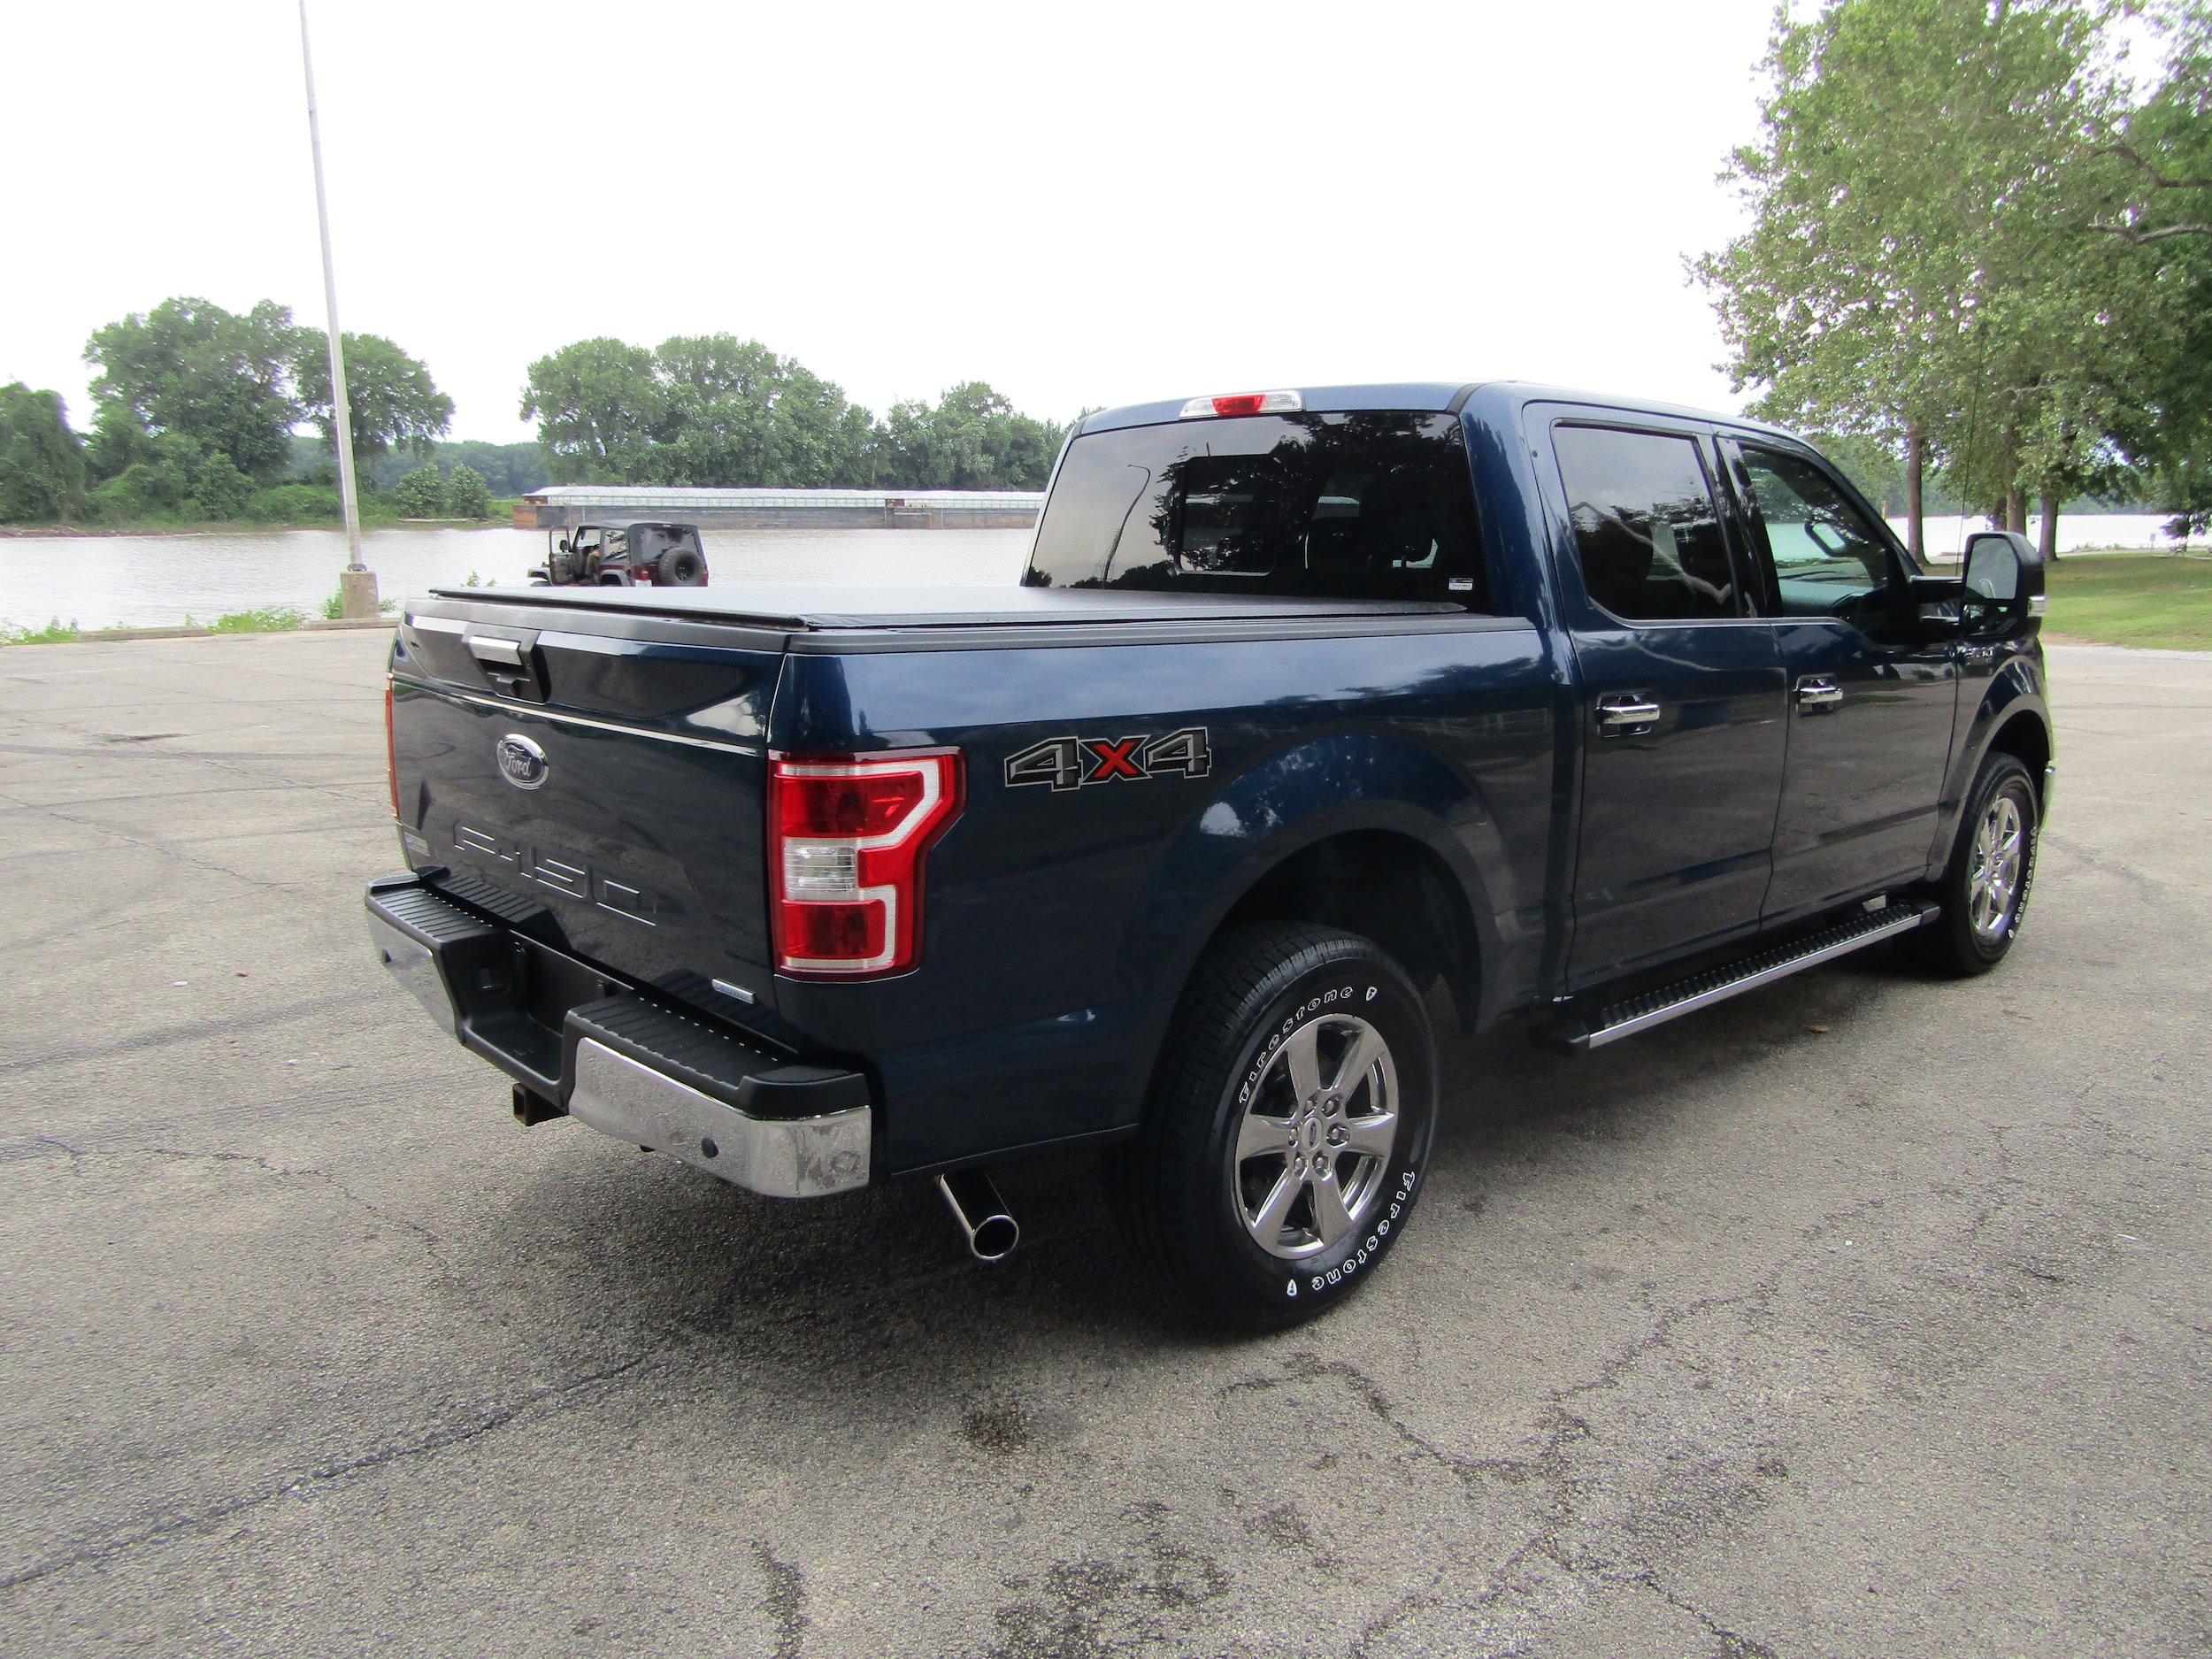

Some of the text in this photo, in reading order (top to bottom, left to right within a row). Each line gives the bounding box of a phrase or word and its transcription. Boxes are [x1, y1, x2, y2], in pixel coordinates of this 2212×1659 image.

[505, 744, 532, 777] Ford
[1239, 986, 1353, 1104] Firestone
[1311, 1171, 1416, 1291] Firestone
